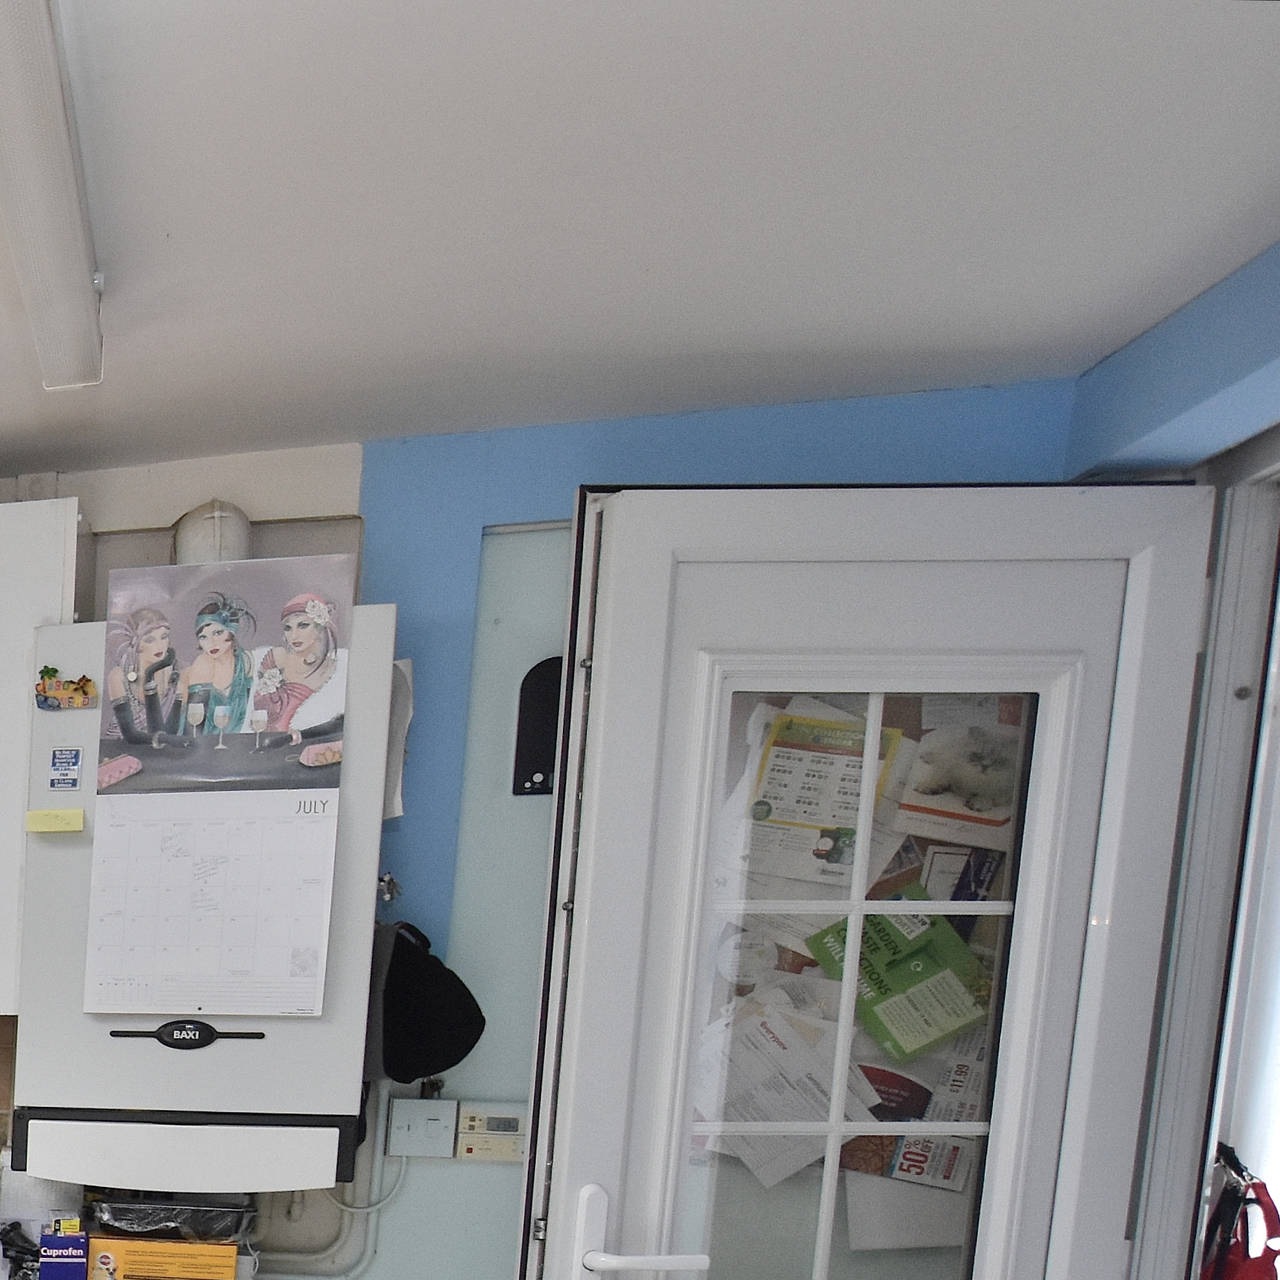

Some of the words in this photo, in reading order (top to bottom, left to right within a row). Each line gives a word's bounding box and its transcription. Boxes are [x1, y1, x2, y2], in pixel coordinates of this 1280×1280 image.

[295, 799, 329, 814] JULY
[861, 927, 881, 956] ASTE
[866, 914, 902, 956] GARDEN
[173, 1030, 199, 1040] BAXI
[40, 1247, 84, 1257] Cuprofen
